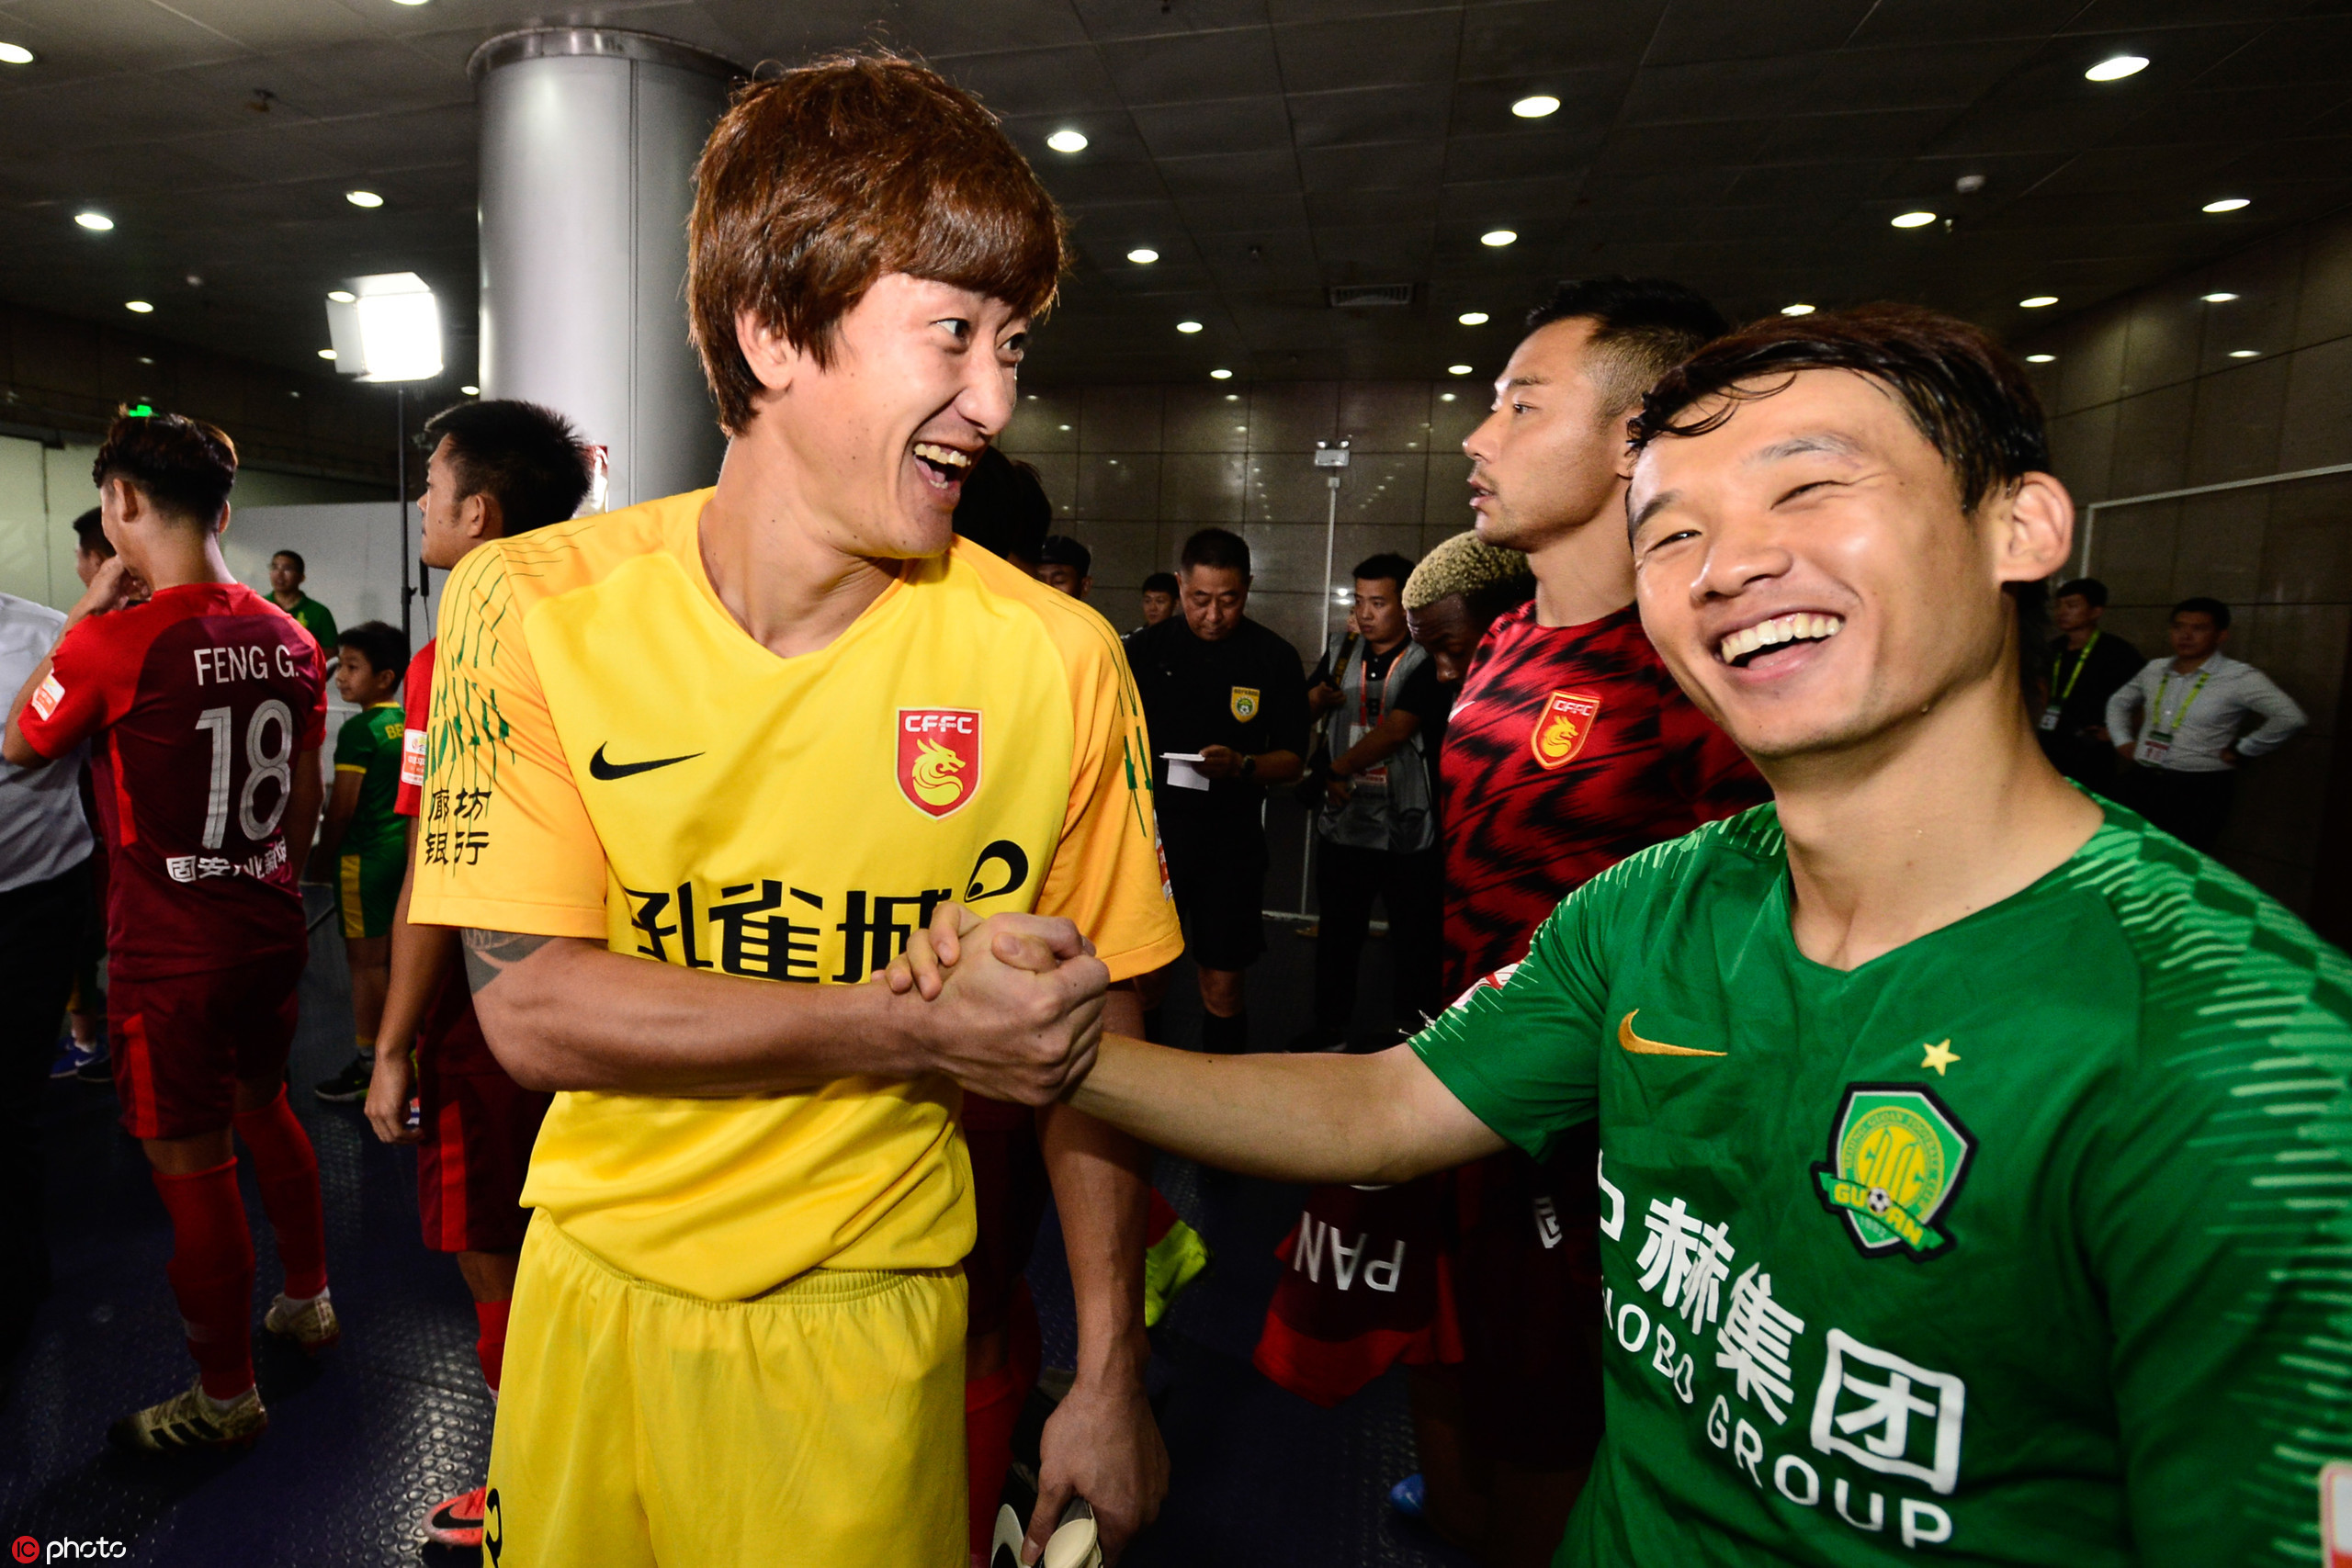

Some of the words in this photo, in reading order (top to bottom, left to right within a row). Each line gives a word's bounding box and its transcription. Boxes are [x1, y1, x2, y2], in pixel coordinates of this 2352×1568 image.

[194, 646, 268, 685] FENG
[276, 645, 300, 677] G.
[904, 715, 973, 734] CFFC
[195, 699, 293, 849] 18
[428, 787, 492, 824] 廊坊
[425, 831, 490, 865] 银行
[1294, 1211, 1406, 1292] PAN
[1707, 1394, 1952, 1548] GROUP
